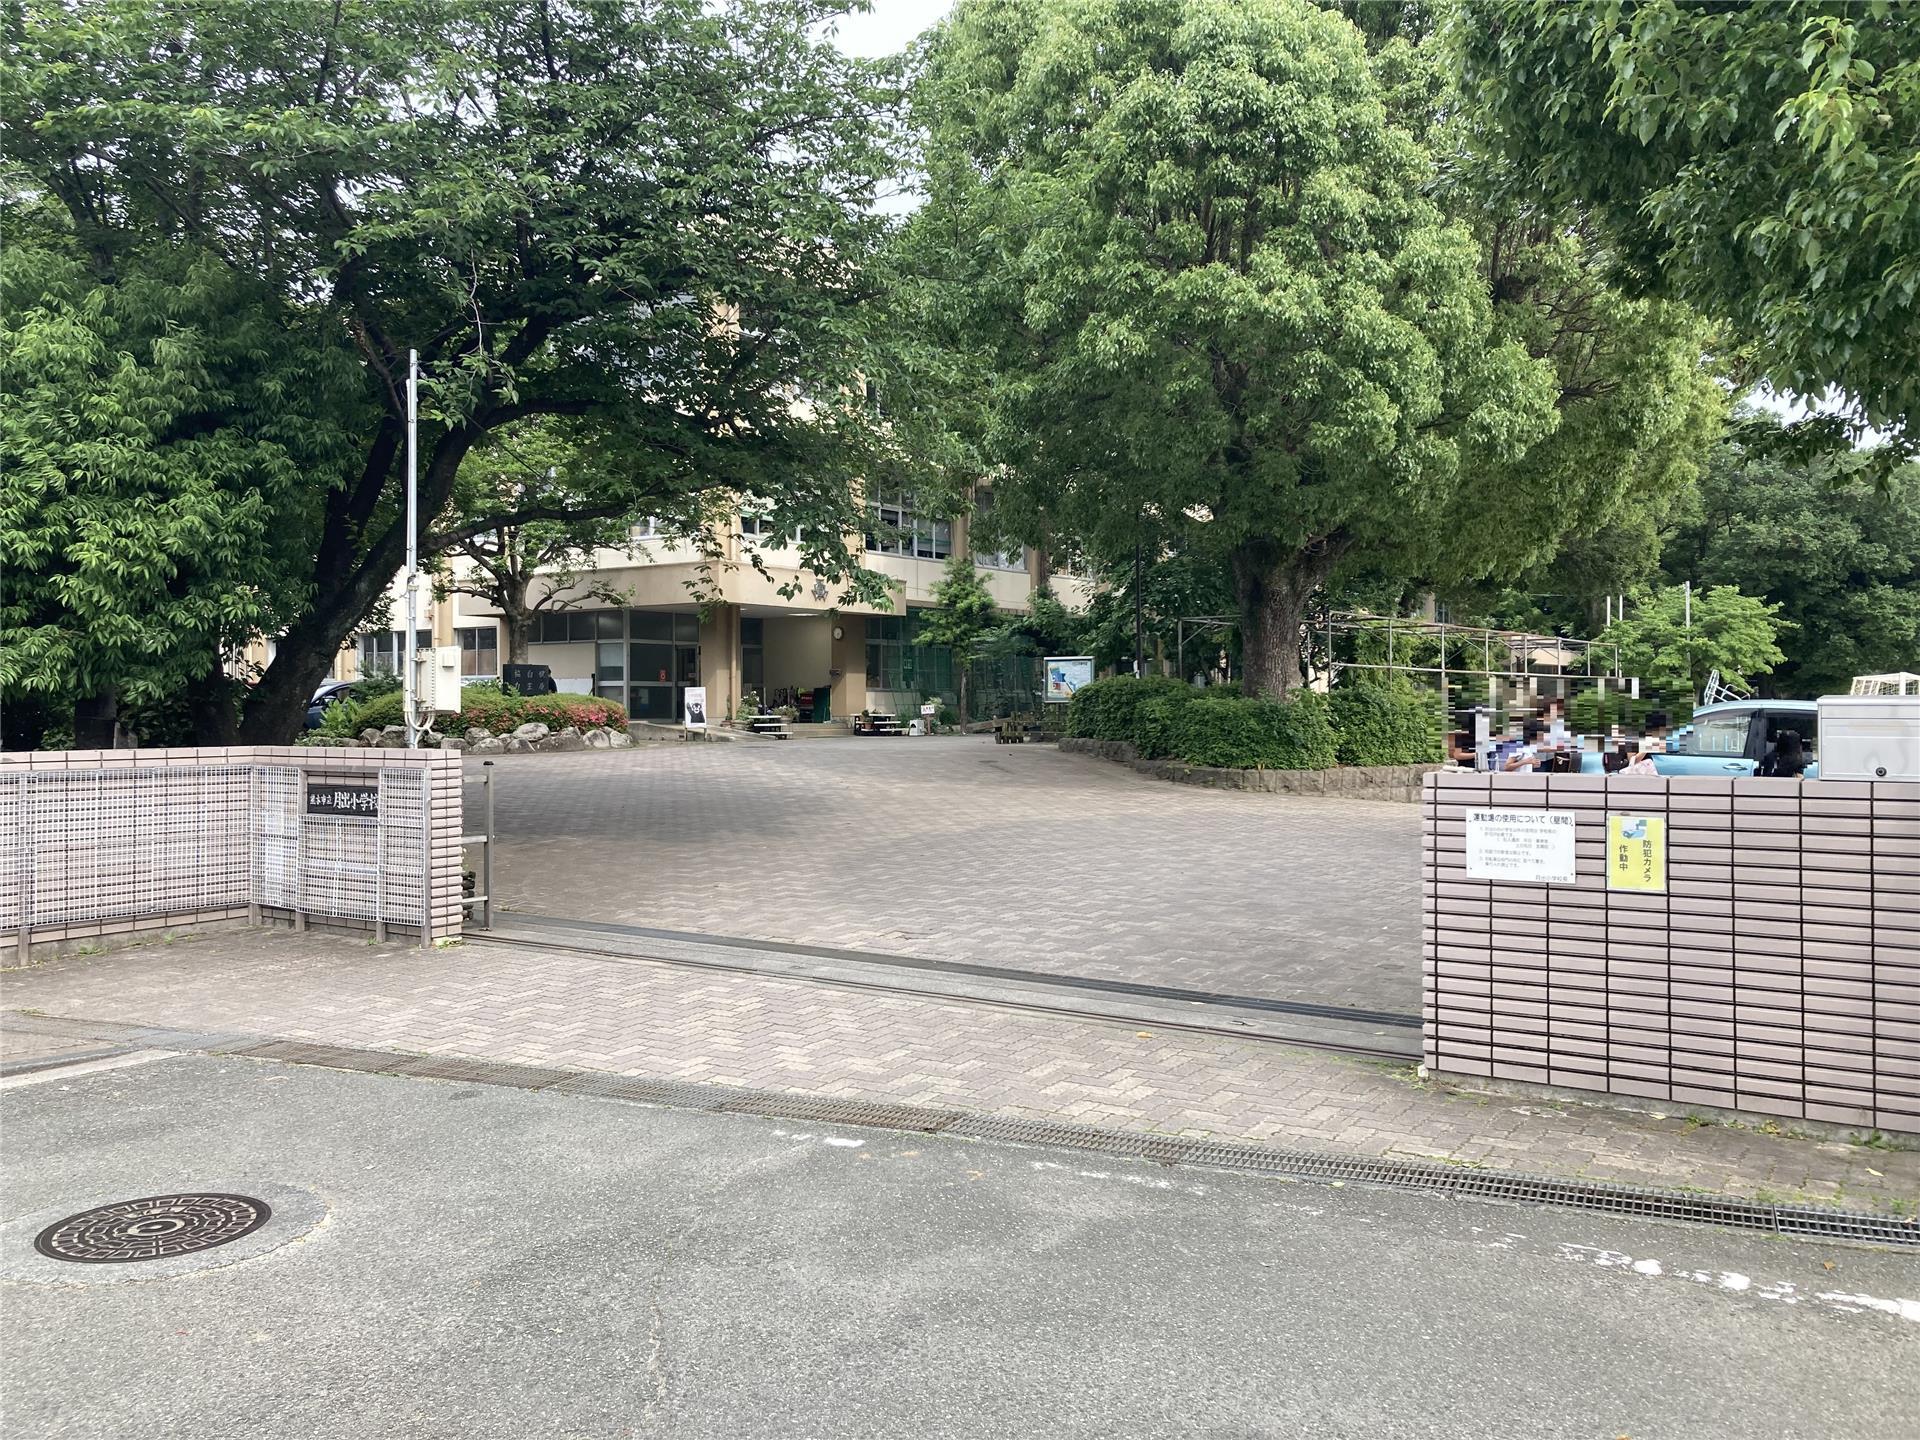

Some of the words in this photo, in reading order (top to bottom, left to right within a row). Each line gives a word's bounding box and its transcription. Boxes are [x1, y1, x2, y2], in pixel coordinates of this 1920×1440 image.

[1619, 844, 1628, 871] 作動中
[1642, 839, 1652, 882] 防犯カメラ
